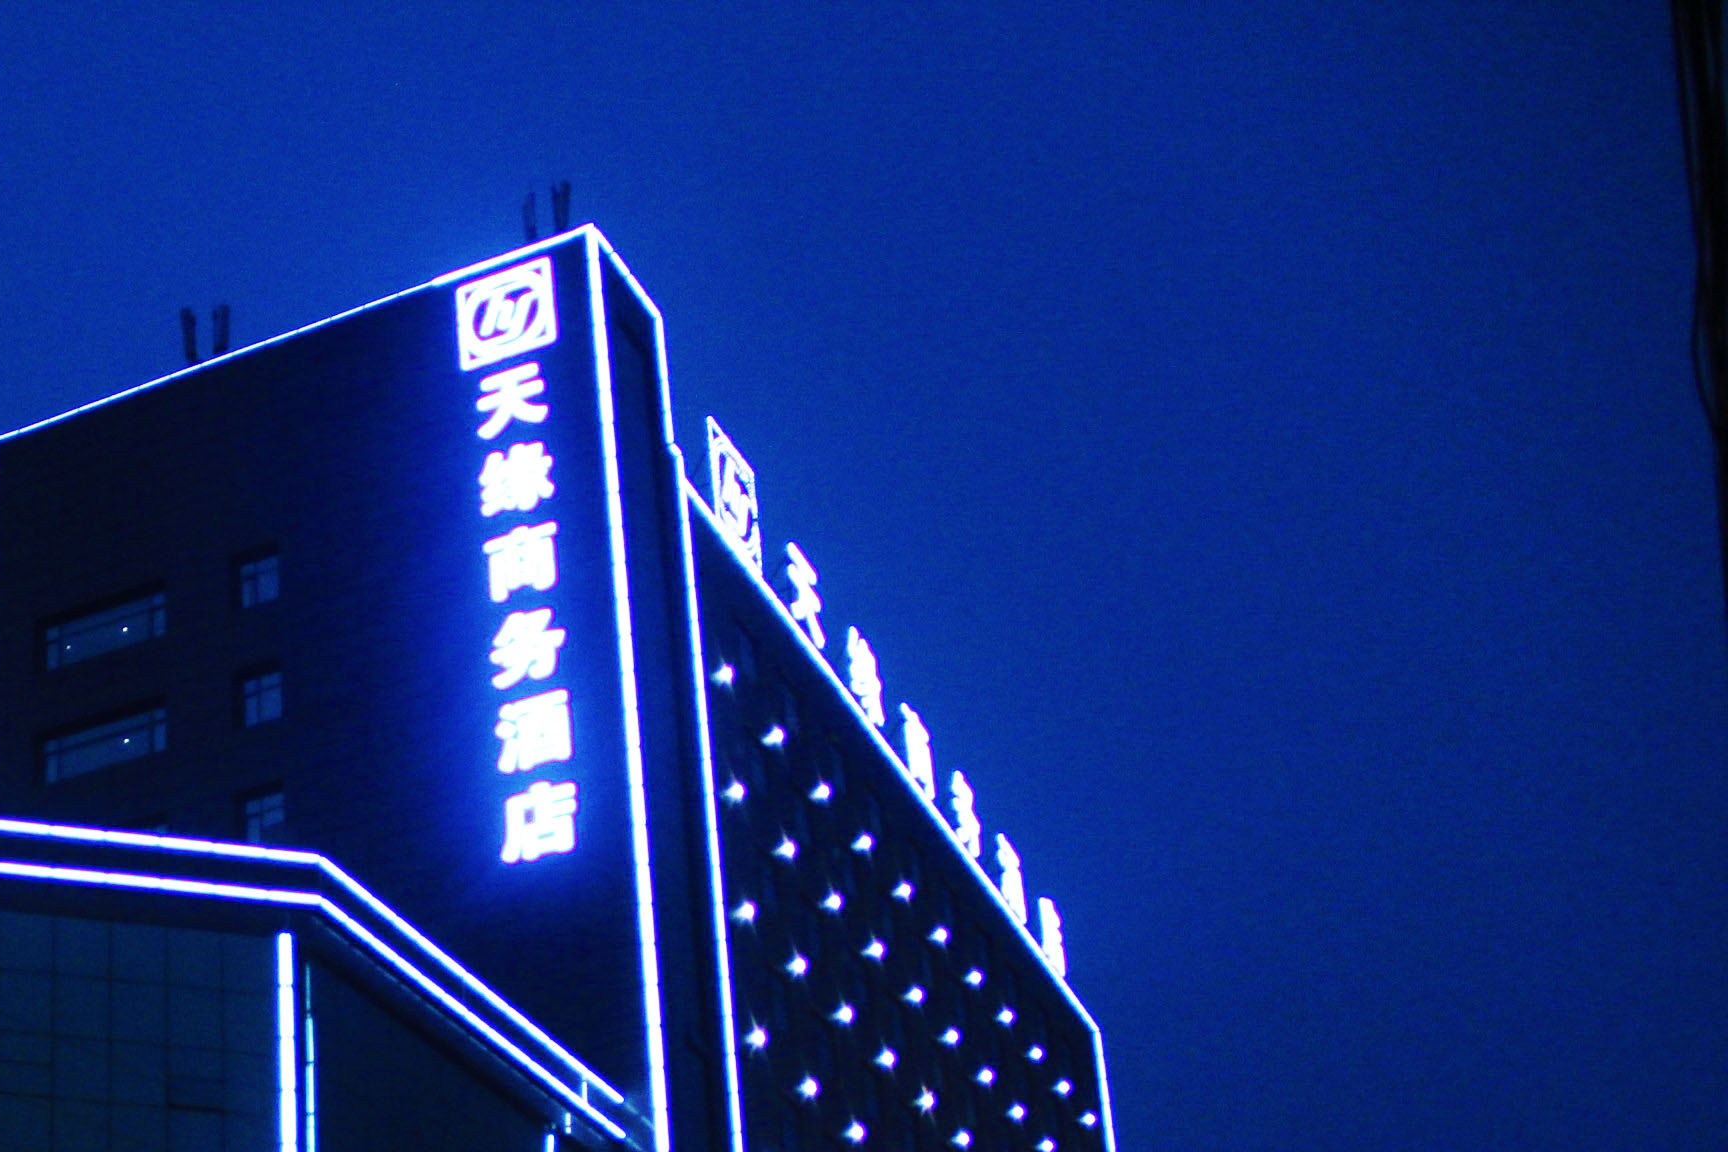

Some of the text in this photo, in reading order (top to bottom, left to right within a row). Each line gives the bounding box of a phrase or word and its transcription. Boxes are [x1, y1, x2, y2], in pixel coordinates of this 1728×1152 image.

[475, 360, 579, 865] 天缘商务酒店
